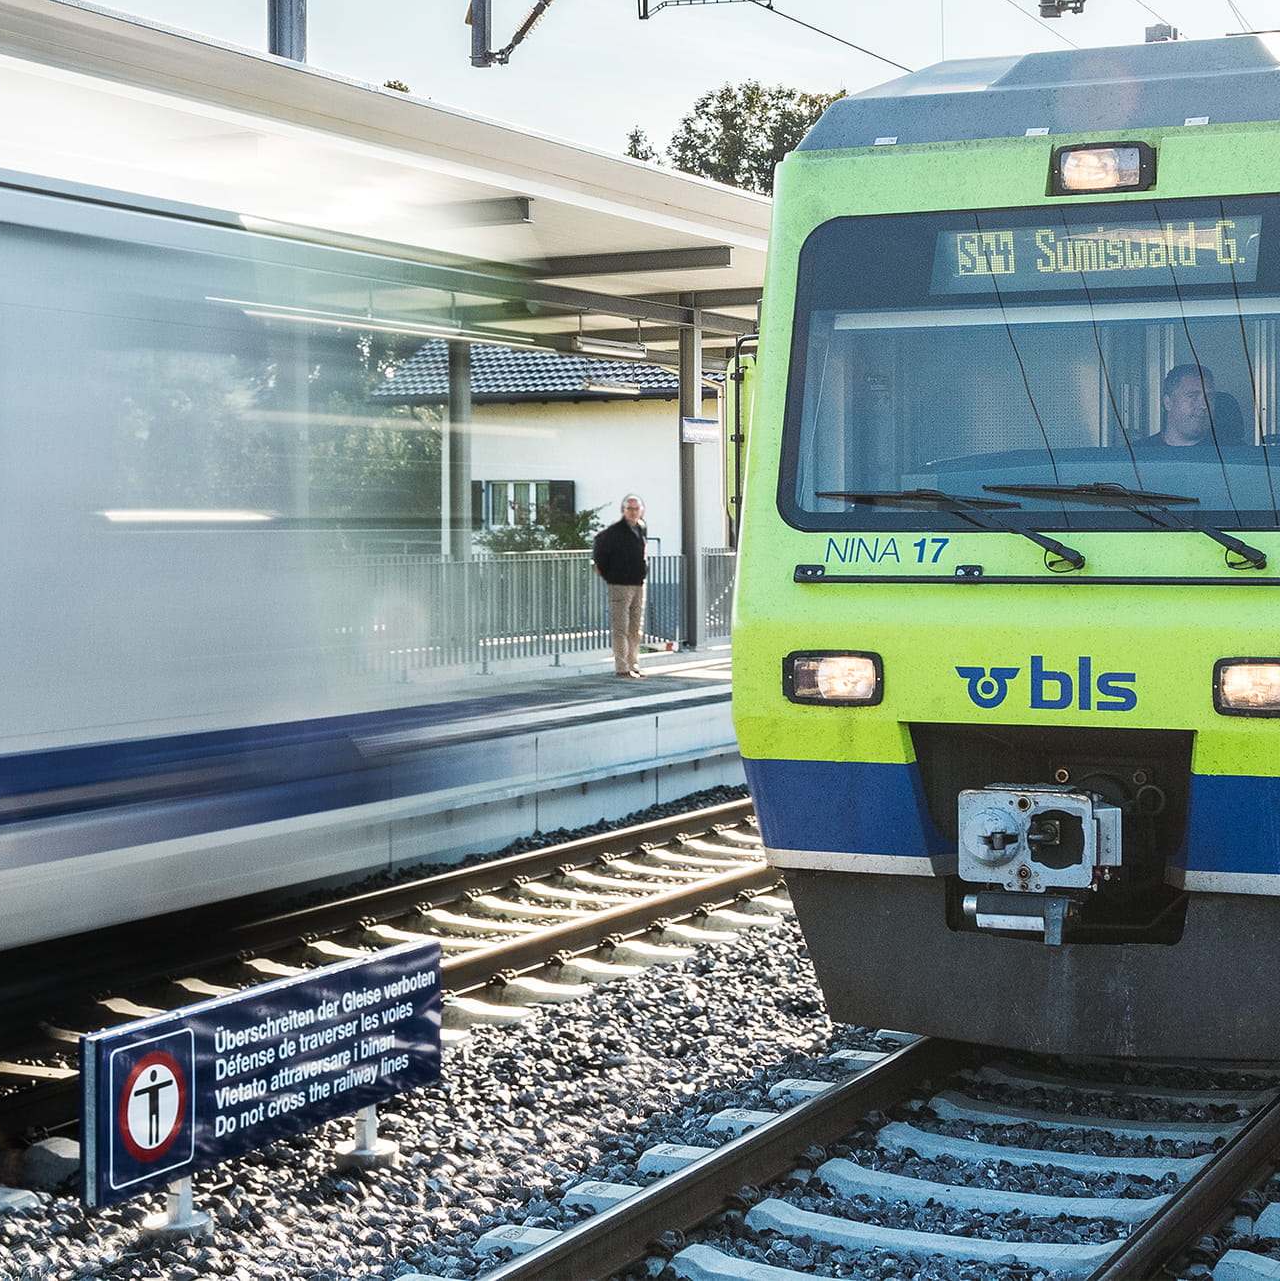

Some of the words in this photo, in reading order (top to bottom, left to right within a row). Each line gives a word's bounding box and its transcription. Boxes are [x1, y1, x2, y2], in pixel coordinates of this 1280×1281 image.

[957, 231, 1015, 276] S44
[825, 537, 900, 563] NINA
[913, 537, 950, 563] 17
[1029, 655, 1138, 712] bls
[214, 1008, 315, 1053] Überschreiten
[317, 999, 340, 1021] der
[342, 987, 381, 1013] Gleise
[383, 970, 436, 999] verboten
[215, 1047, 276, 1081] Défense
[278, 1038, 297, 1060] de
[299, 1019, 358, 1053] traverser
[361, 1012, 379, 1032] les
[381, 1001, 413, 1025] voies
[214, 1078, 267, 1110] Vietato
[270, 1049, 351, 1091] attraversare
[353, 1042, 358, 1062] i
[361, 1030, 395, 1059] binari
[215, 1115, 237, 1138] Do
[240, 1102, 264, 1129] not
[267, 1091, 306, 1118] cross
[309, 1081, 331, 1103] the
[333, 1064, 378, 1094] railway
[380, 1053, 409, 1077] lines
